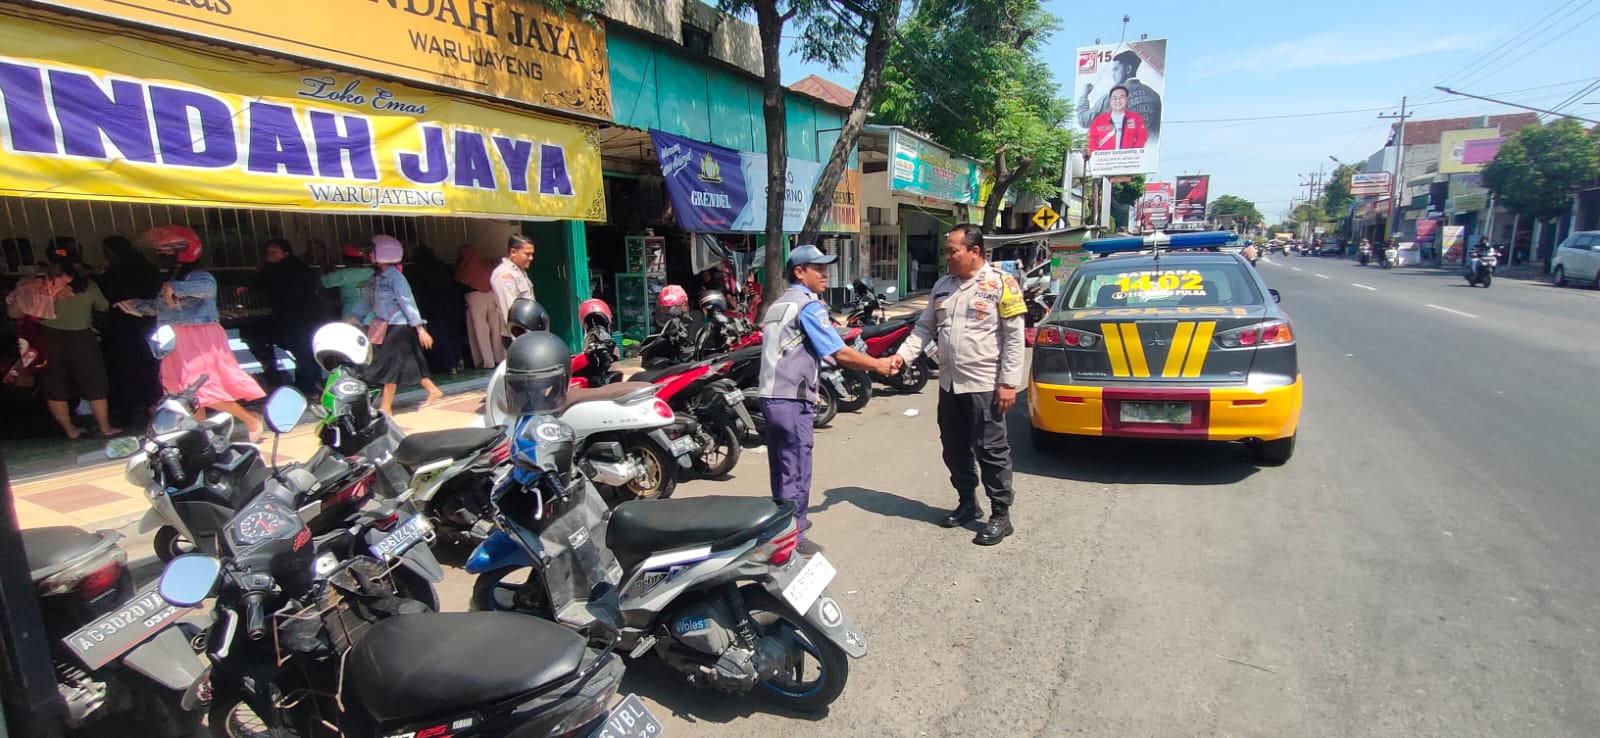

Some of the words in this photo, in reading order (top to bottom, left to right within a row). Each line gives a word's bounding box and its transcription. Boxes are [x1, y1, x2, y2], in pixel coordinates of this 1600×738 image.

[507, 10, 585, 63] JAYA
[408, 29, 543, 81] WARUJAYENG
[1097, 51, 1113, 63] 15
[298, 76, 367, 105] Toko
[372, 88, 428, 115] Emas
[0, 61, 378, 180] INDAH
[399, 125, 574, 196] JAYA
[309, 184, 445, 208] WARUJAYENG
[1073, 307, 1247, 319] POLISI
[79, 629, 105, 651] AG
[100, 604, 146, 634] 3020
[675, 619, 704, 633] Woles
[609, 703, 645, 736] VBL
